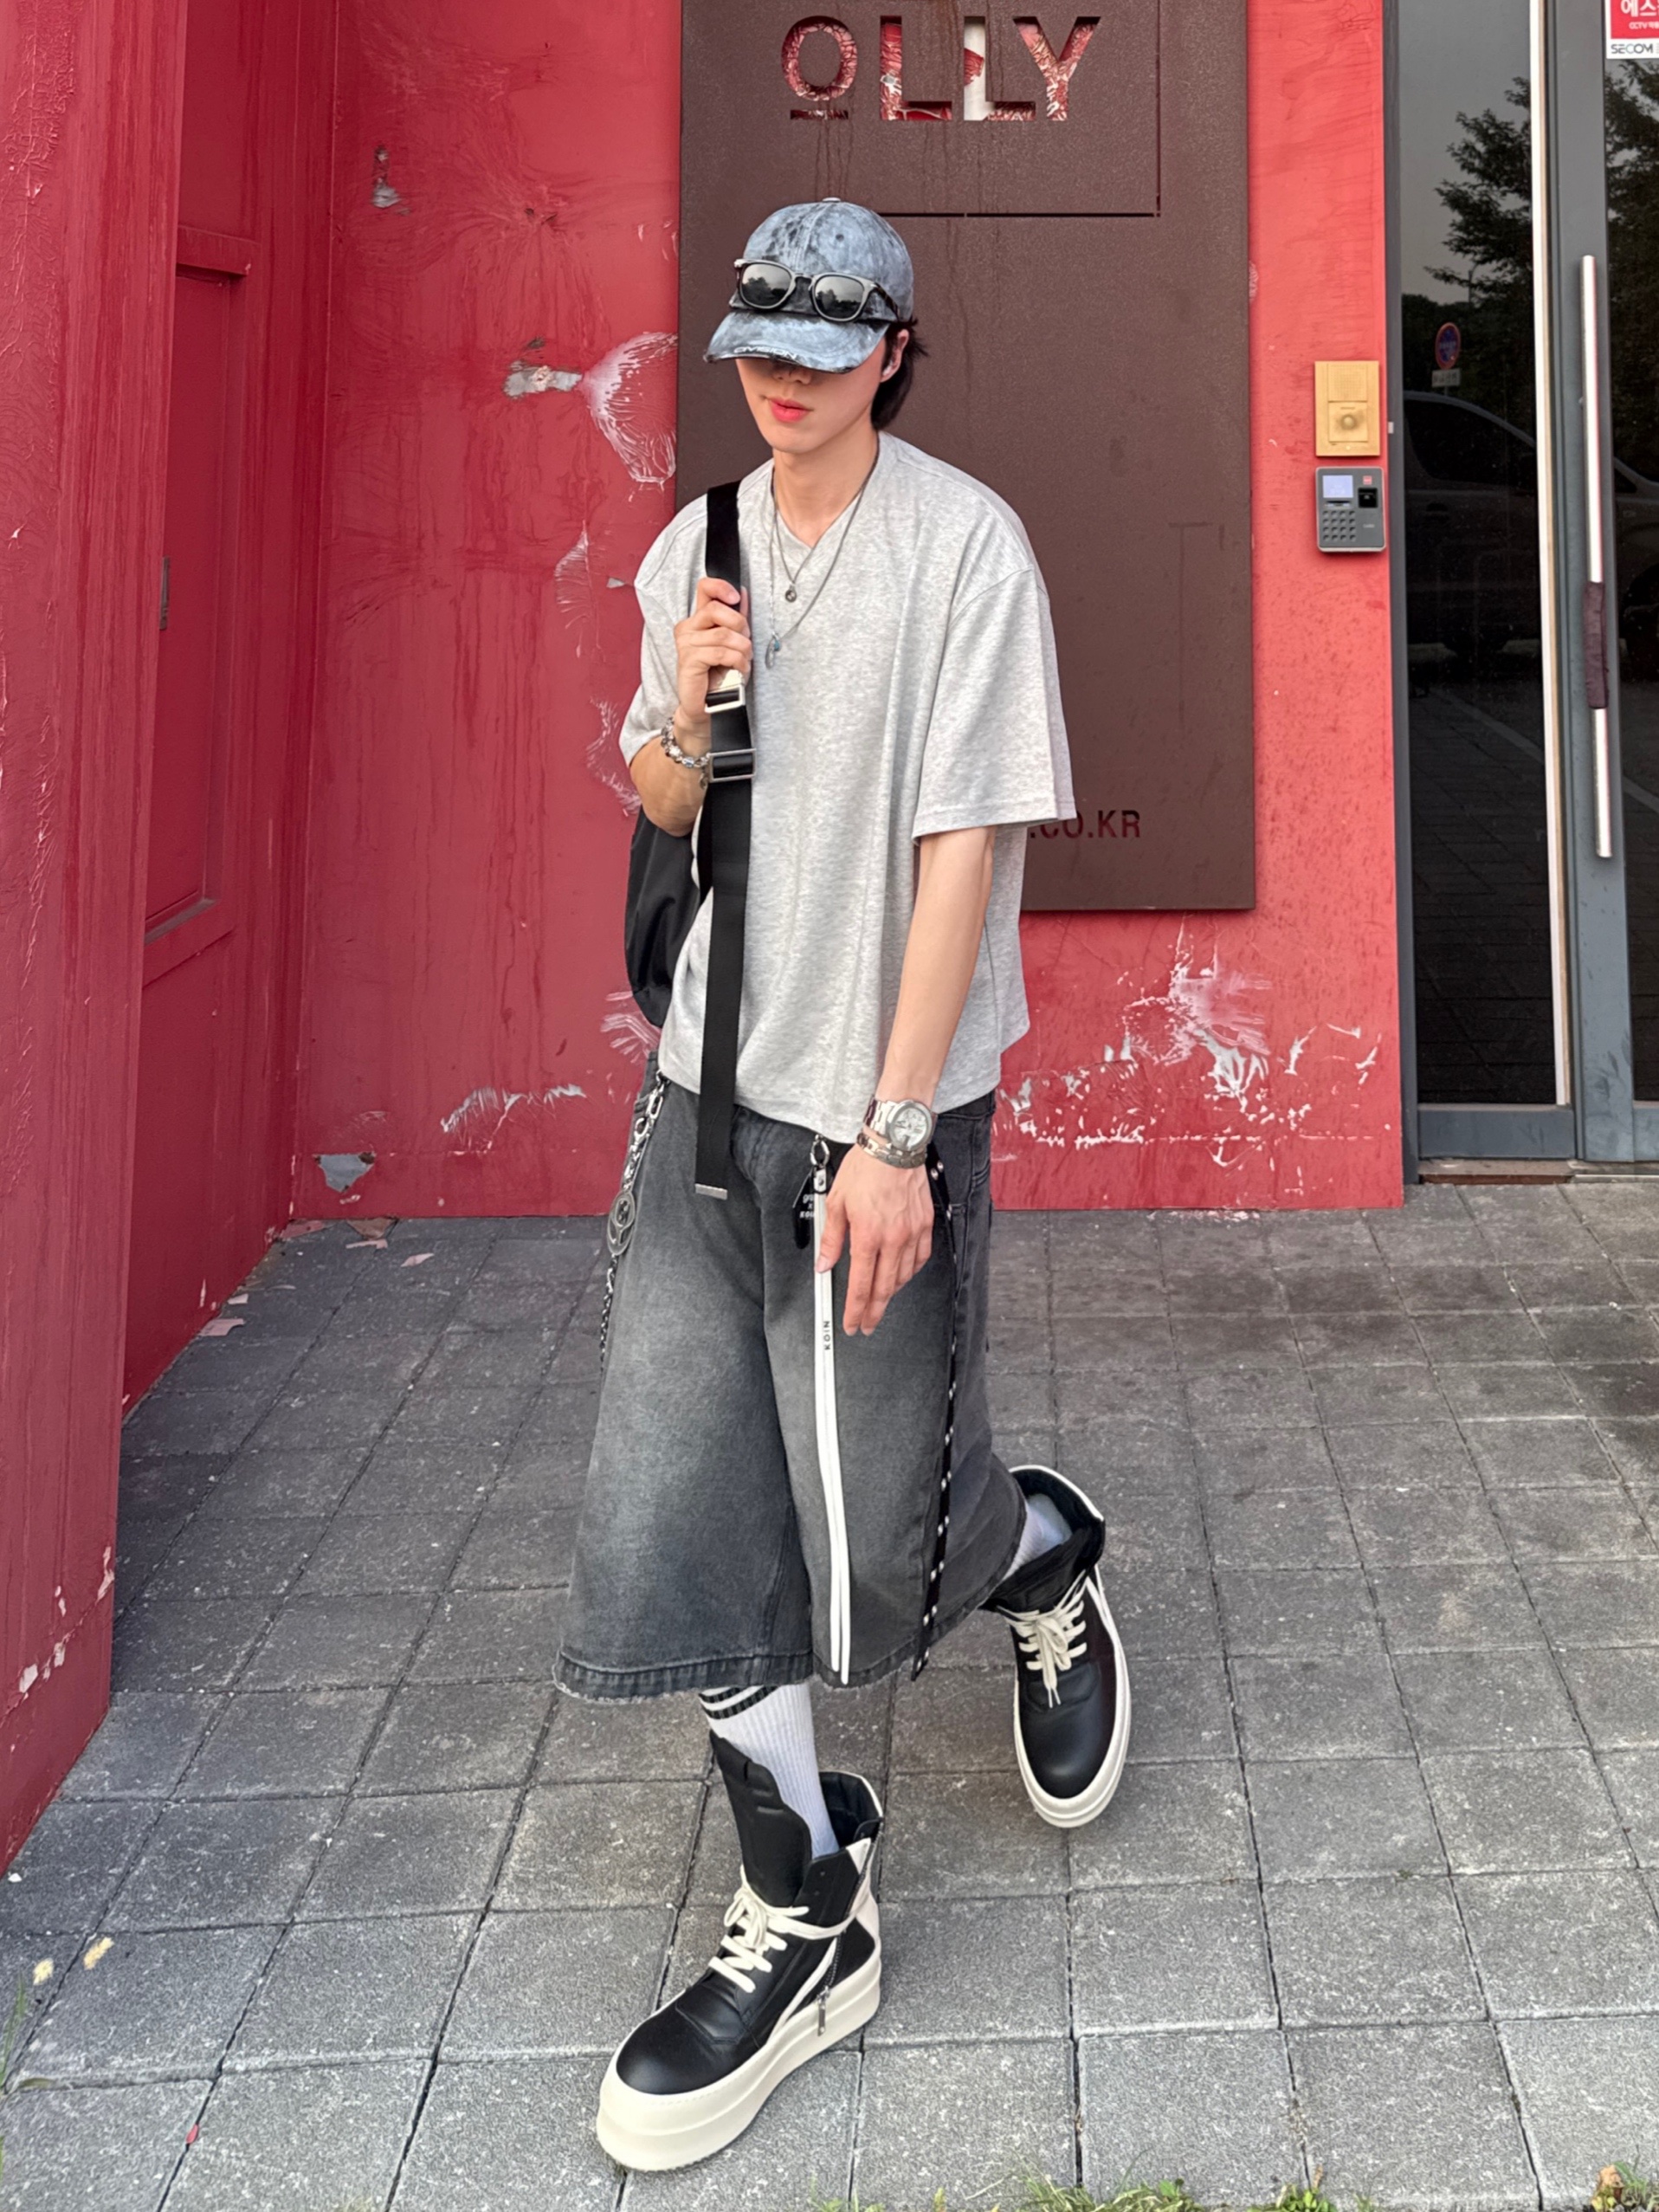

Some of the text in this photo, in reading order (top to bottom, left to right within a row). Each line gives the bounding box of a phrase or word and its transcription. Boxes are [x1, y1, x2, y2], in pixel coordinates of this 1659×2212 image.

[1621, 0, 1659, 17] 에스
[1611, 43, 1654, 55] SECOM
[781, 16, 1101, 121] OLLY
[823, 1320, 831, 1350] KOIN
